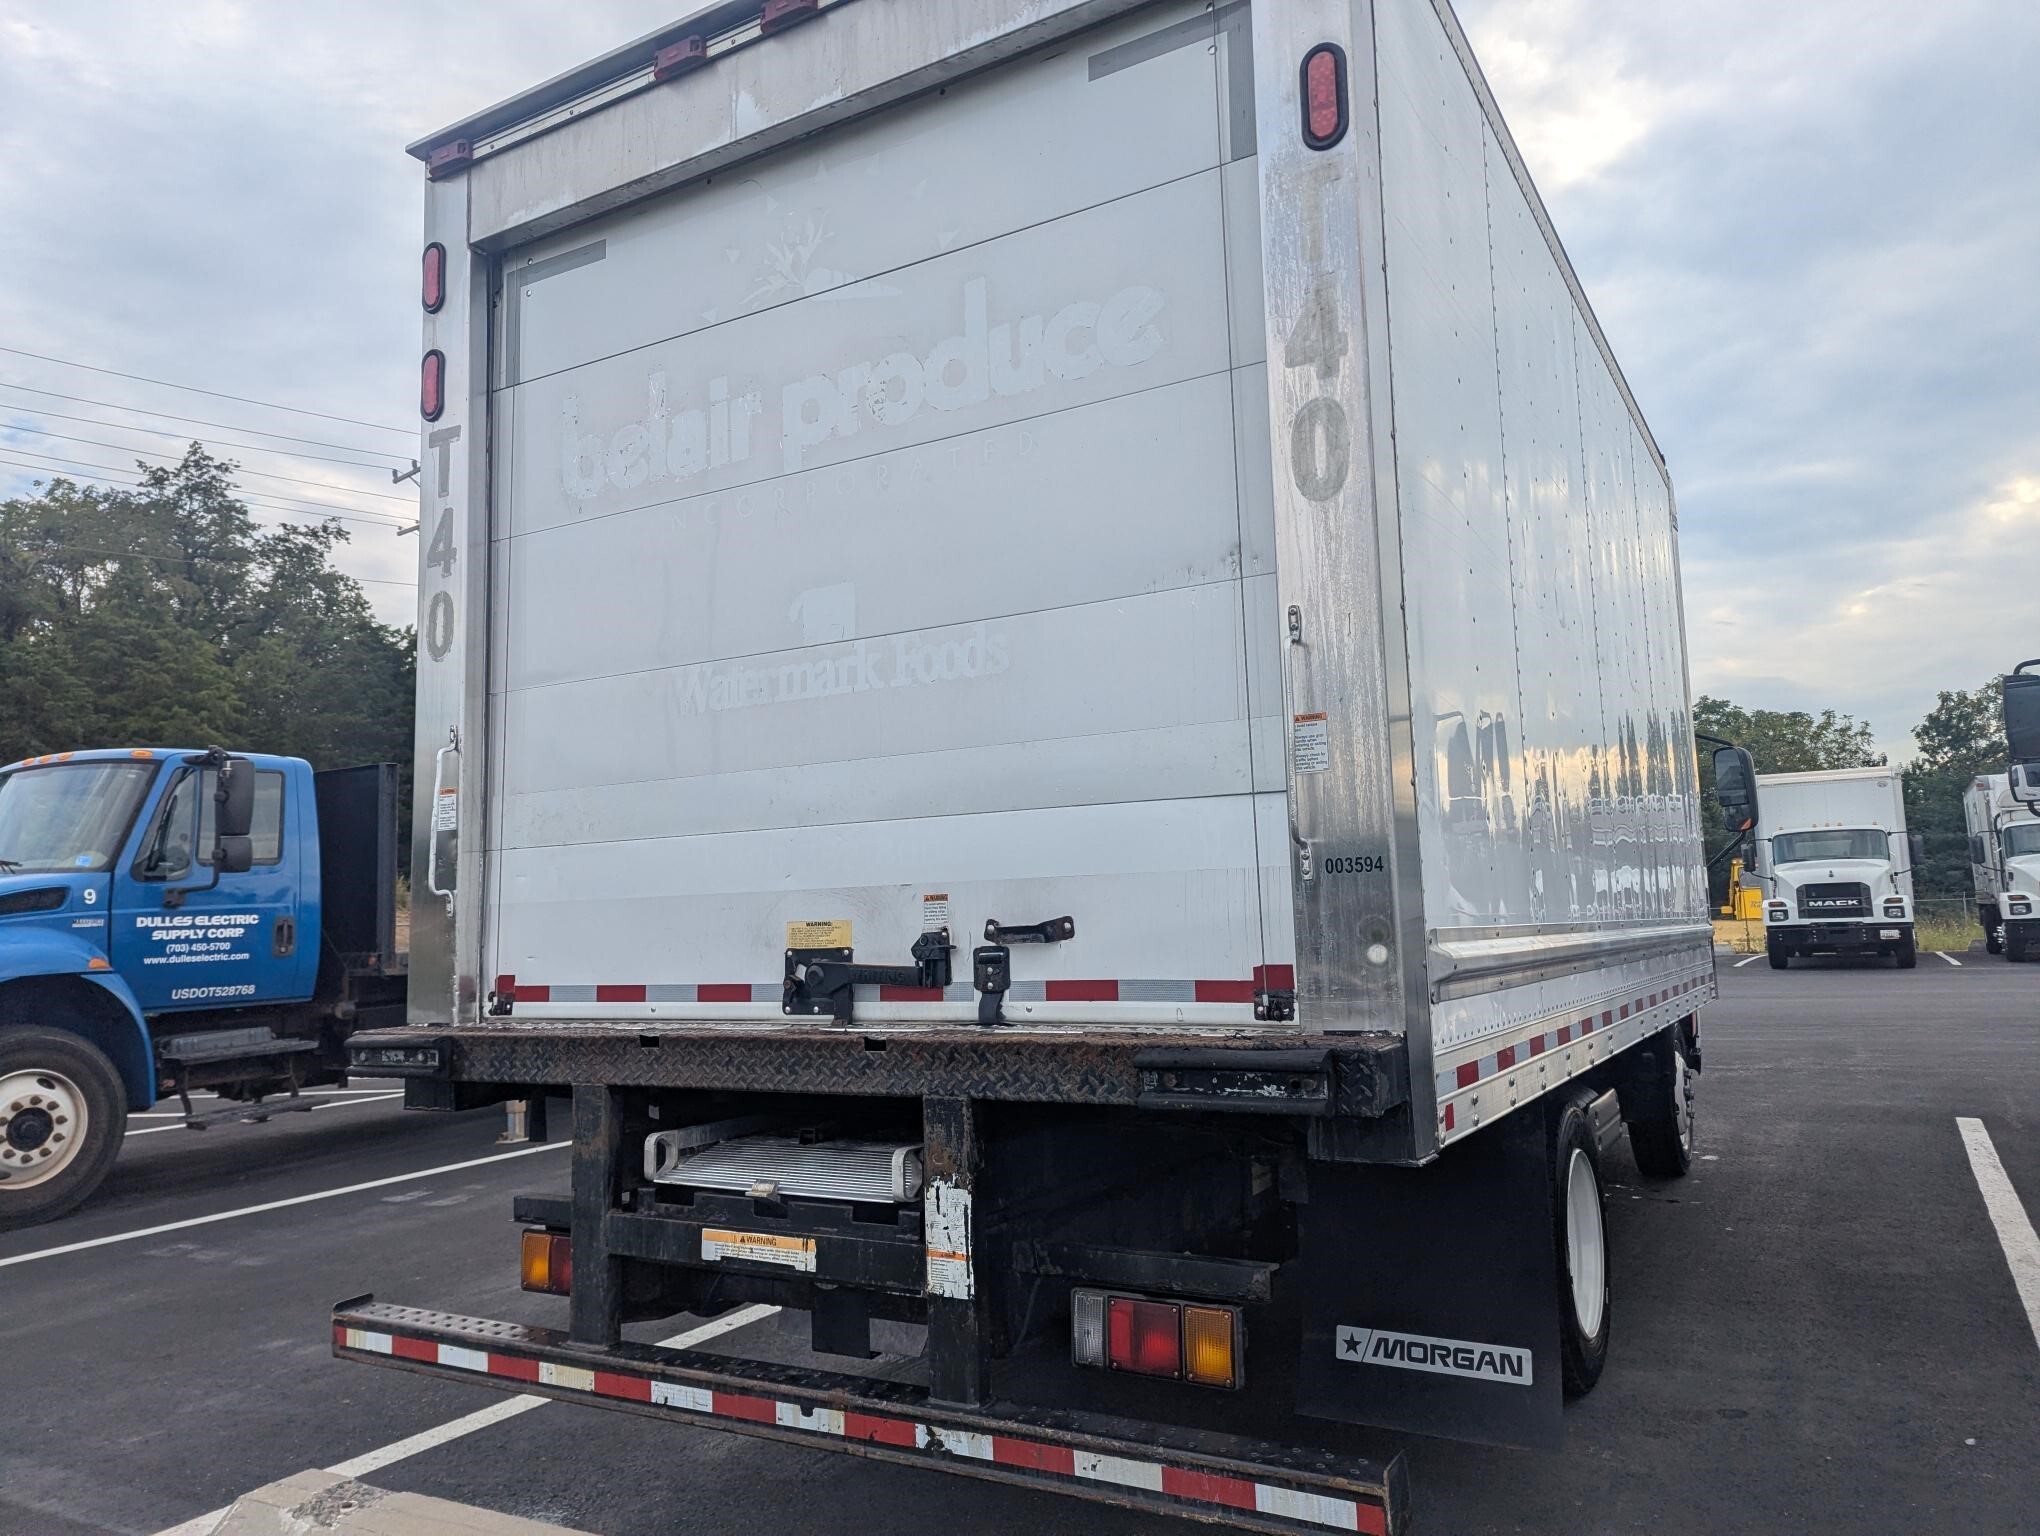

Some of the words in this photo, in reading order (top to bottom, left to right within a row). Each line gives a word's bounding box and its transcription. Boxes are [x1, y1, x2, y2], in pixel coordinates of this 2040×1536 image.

[781, 275, 1167, 472] produce
[669, 431, 1034, 533] NCORPORATED
[426, 424, 462, 663] T40
[675, 640, 886, 717] Watermark
[889, 622, 1011, 686] Foods
[1325, 856, 1384, 875] 003594
[83, 889, 96, 905] 9
[1808, 899, 1860, 907] MACK
[136, 916, 193, 928] DULLES
[194, 914, 260, 926] ELECTRIC
[151, 929, 206, 941] SUPPLY
[166, 943, 189, 954] (703)
[191, 942, 231, 952] 450-5700
[143, 952, 250, 965] www.dulleselectric.com
[171, 984, 256, 1000] USDOT528768
[747, 1235, 777, 1246] WARNING
[1372, 1337, 1523, 1377] MORGAN
